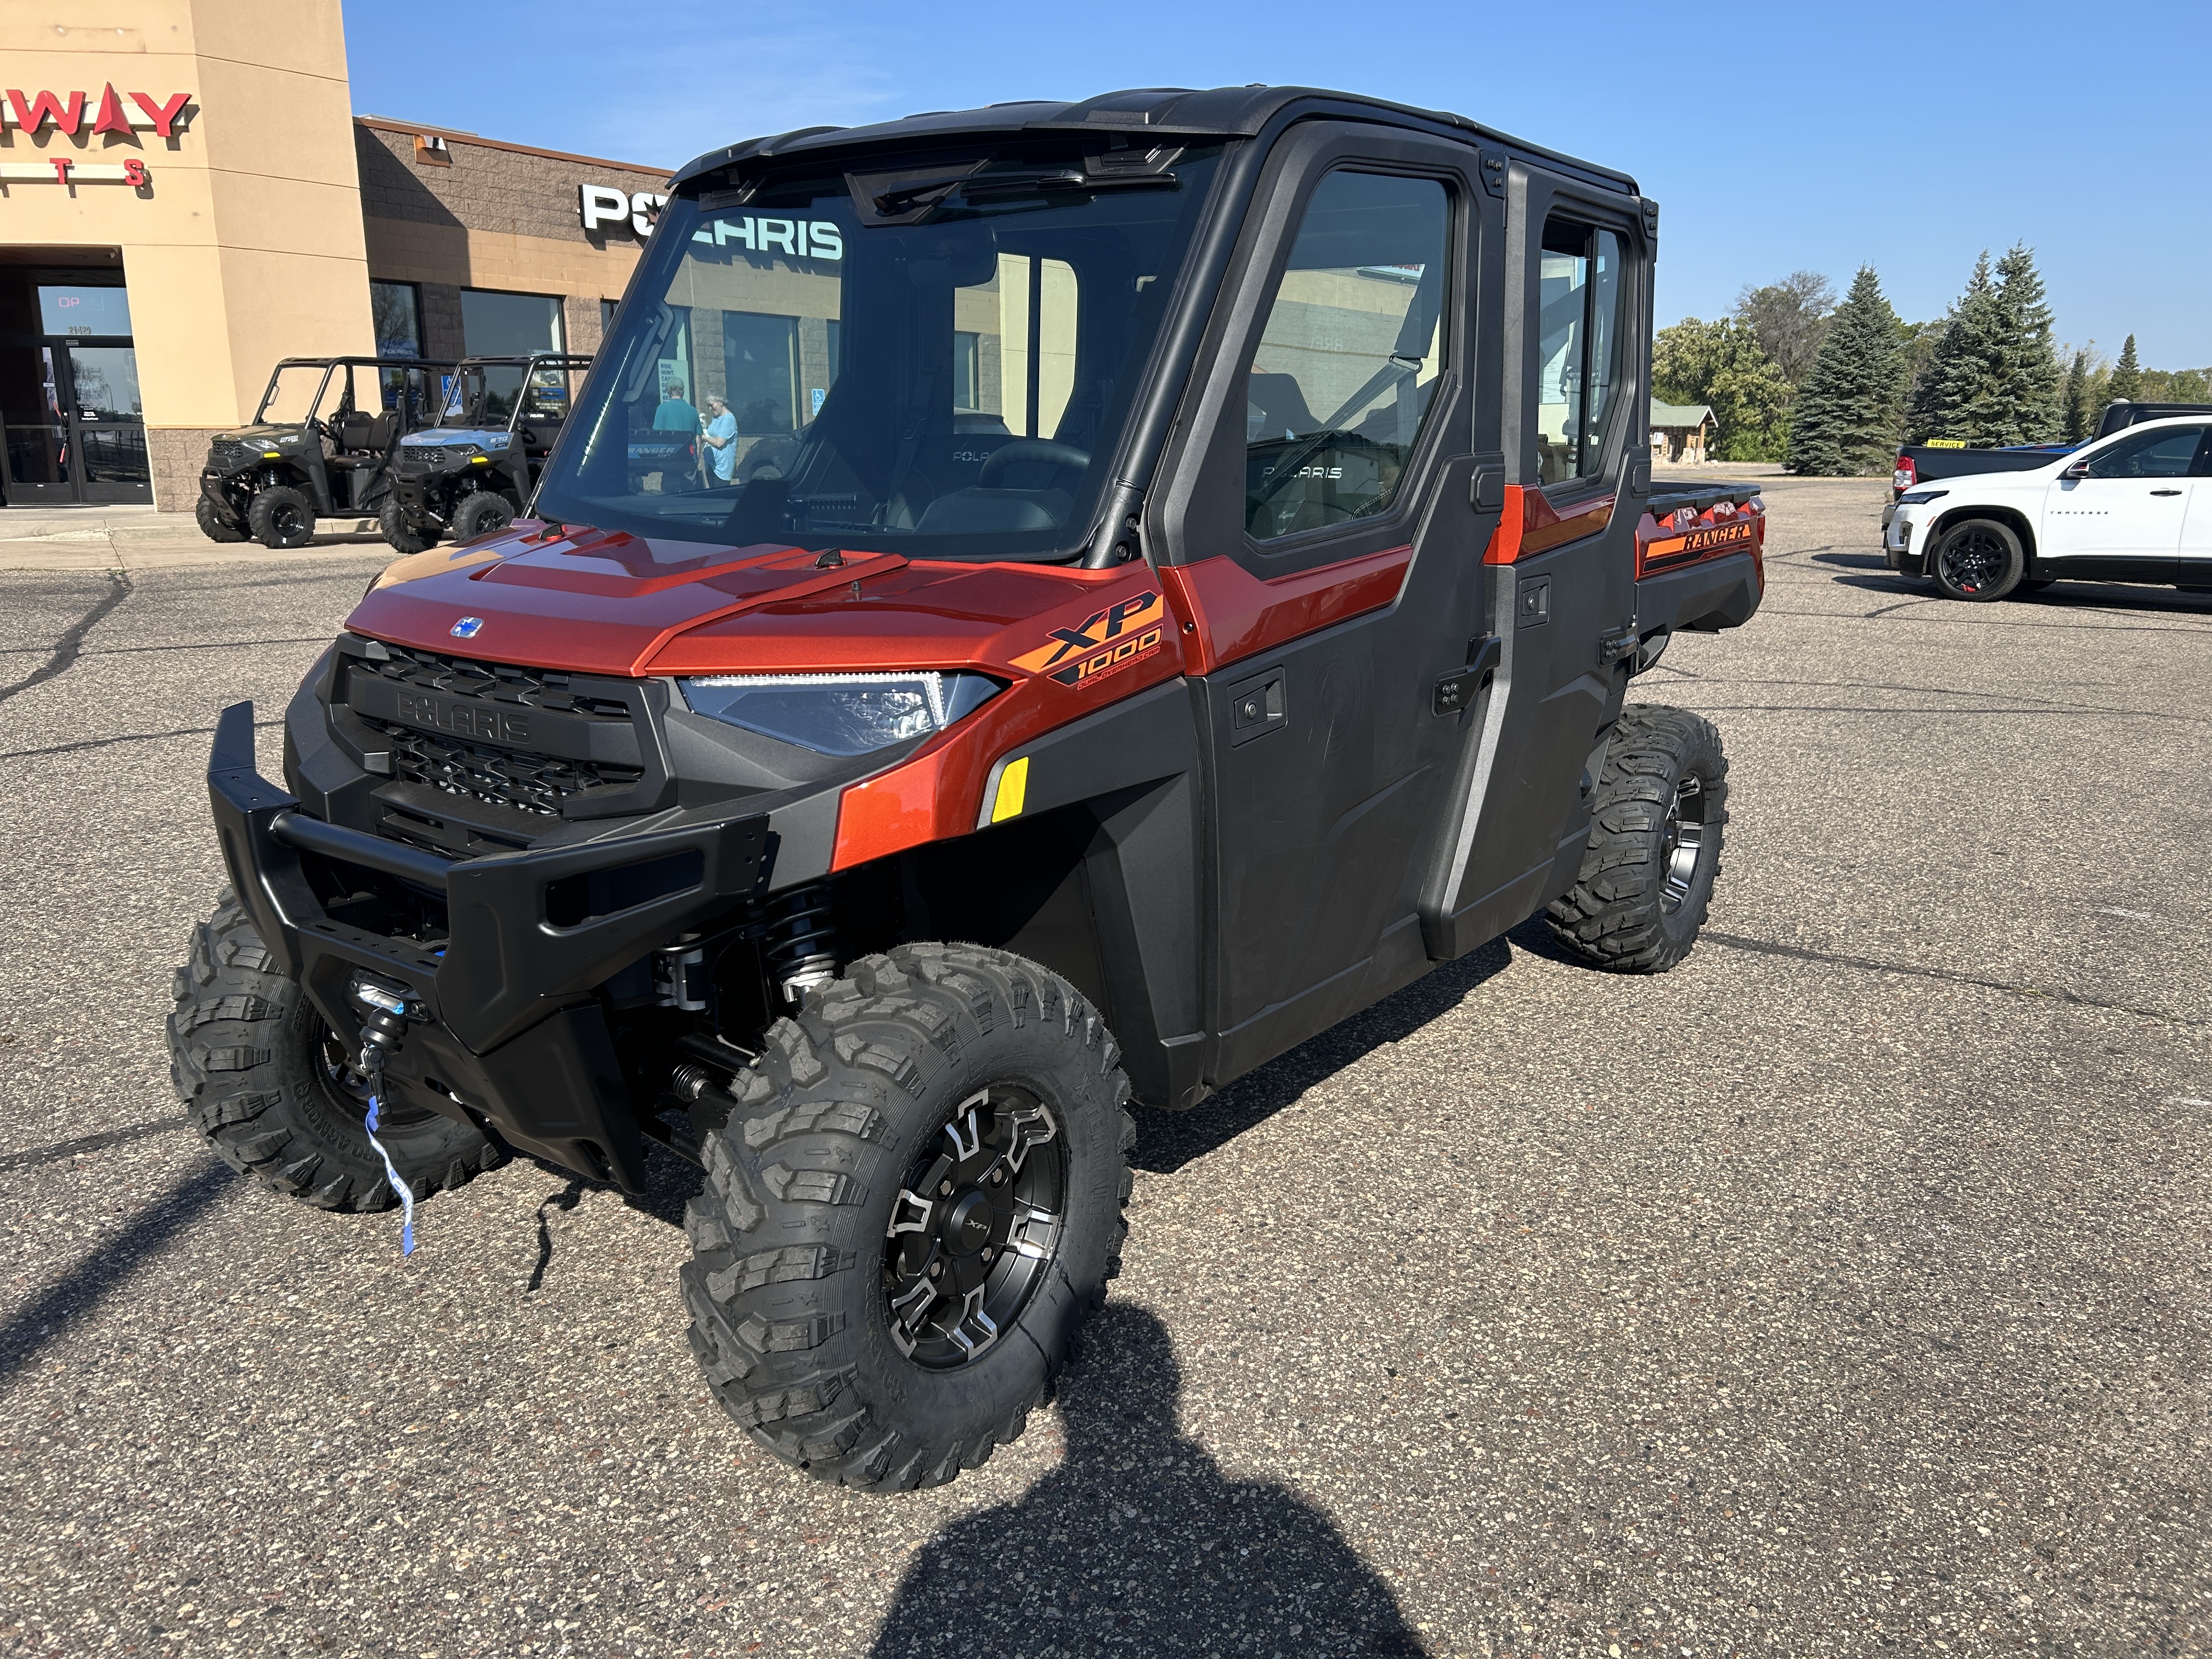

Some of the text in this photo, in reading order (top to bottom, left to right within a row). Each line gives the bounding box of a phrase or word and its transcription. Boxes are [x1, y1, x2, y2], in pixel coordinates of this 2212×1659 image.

[0, 81, 192, 137] WAY
[952, 451, 990, 461] POLA
[1683, 523, 1746, 552] RANGER
[1040, 590, 1158, 669] XP
[1078, 628, 1161, 679] 1000
[397, 691, 531, 744] POLARIS
[302, 1096, 351, 1151] ARMOR
[1073, 1071, 1110, 1215] X-TERRAIN
[966, 1218, 987, 1229] XP
